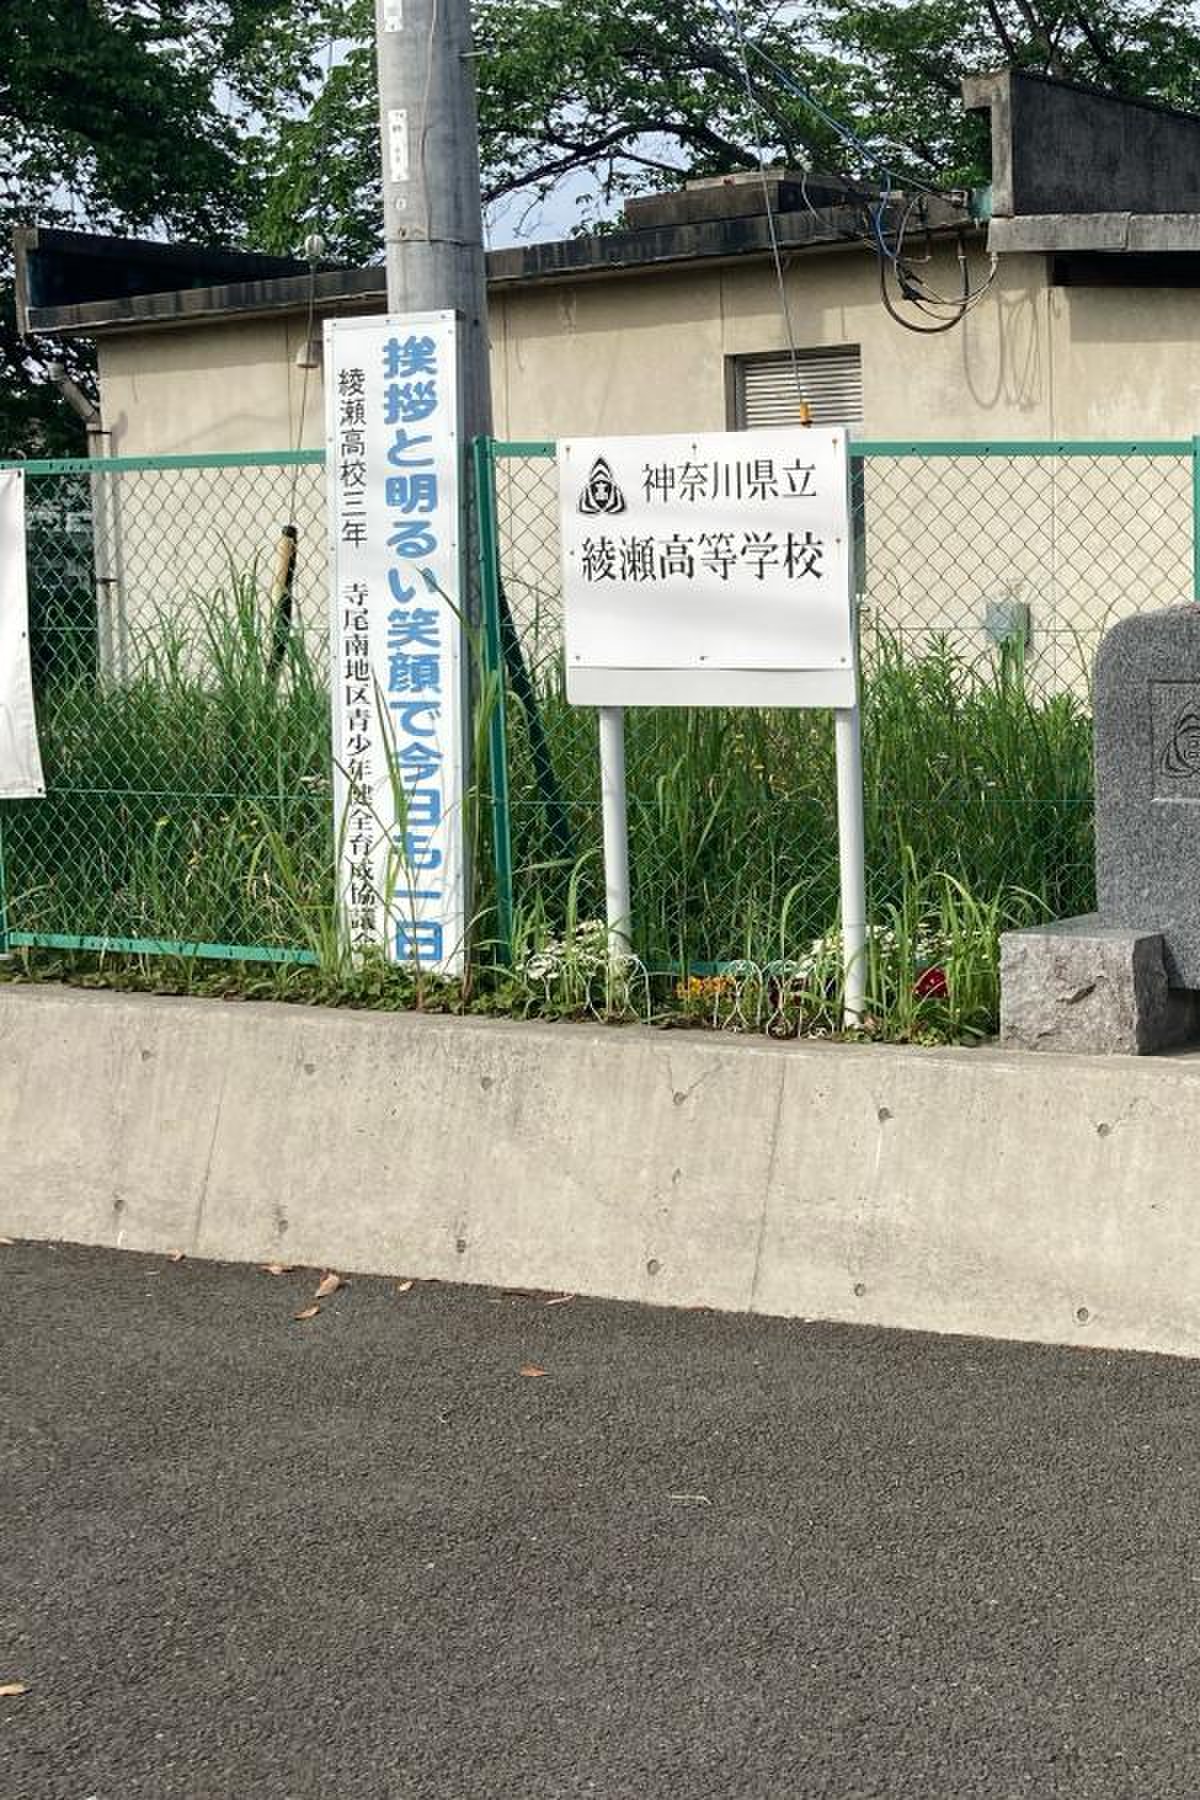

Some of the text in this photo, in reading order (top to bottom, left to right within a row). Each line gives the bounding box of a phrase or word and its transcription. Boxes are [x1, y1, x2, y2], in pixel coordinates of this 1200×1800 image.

[338, 367, 368, 549] 綾瀬高校三年
[641, 458, 817, 503] 神奈川県立
[581, 531, 825, 583] 綾瀬高等学校
[382, 335, 444, 961] 挨拶と明るい笑顔で今日も一日
